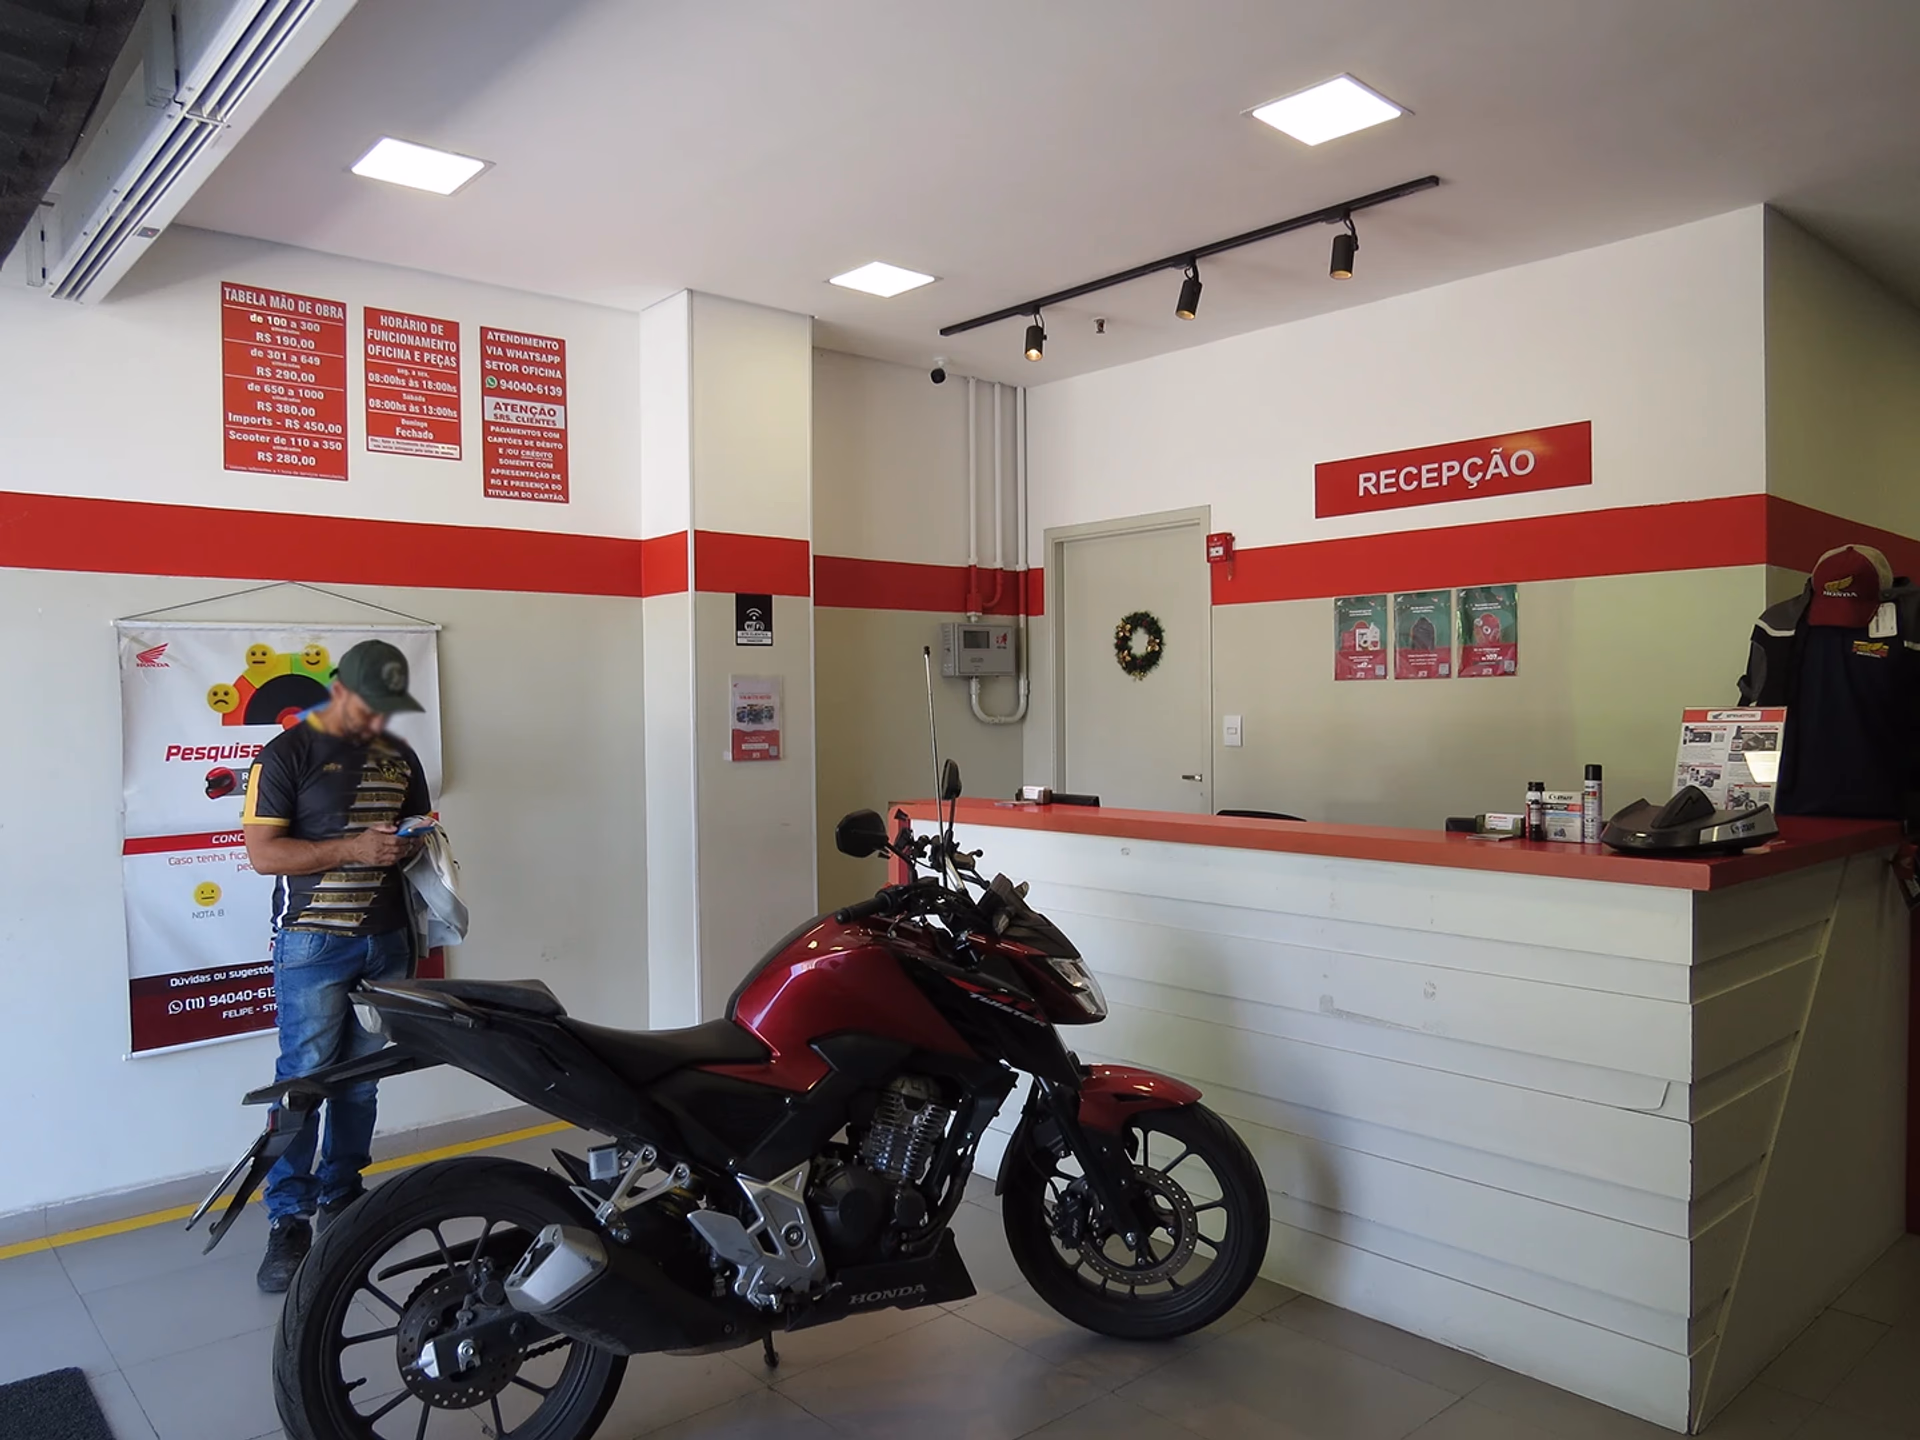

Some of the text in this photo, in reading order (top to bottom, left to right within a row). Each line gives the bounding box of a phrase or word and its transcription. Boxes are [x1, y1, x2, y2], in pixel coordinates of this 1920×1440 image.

[224, 287, 344, 319] TABELA MÃO DE OBRA
[250, 314, 263, 323] de
[267, 315, 287, 326] 100
[291, 320, 296, 328] a
[301, 321, 319, 332] 300
[380, 315, 444, 335] HORÁRIO DE
[256, 332, 314, 349] R$ 190,00
[367, 328, 456, 352] FUNCIONAMENTO
[487, 331, 559, 350] ATENDIMENTO
[251, 348, 263, 357] de
[267, 350, 286, 361] 301
[301, 355, 320, 365] 649
[368, 344, 457, 368] OFICINA E PEÇAS
[486, 346, 560, 364] VIA WHATSAPP
[256, 366, 315, 382] R$ 290,00
[485, 360, 562, 379] SETOR OFICINA
[368, 373, 406, 385] 08:00hs
[500, 379, 562, 396] 94040-6139
[247, 383, 260, 392] de
[264, 384, 284, 395] 650
[288, 388, 294, 396] a
[299, 389, 323, 400] 1000
[257, 401, 315, 417] R$ 380,00
[369, 399, 406, 412] 08:00hs
[494, 402, 556, 417] ATENÇÃO
[228, 412, 272, 426] Imports
[285, 419, 299, 430] R$
[304, 421, 342, 434] 450,00
[516, 416, 556, 426] CLIENTES
[396, 427, 433, 440] Fechado
[490, 426, 541, 436] PAGAMENTOS
[229, 430, 270, 442] Scooter
[274, 436, 286, 445] de
[290, 438, 309, 447] 110
[323, 441, 342, 451] 350
[257, 451, 315, 466] R$ 280,00
[499, 459, 534, 467] SOMENTE
[1358, 448, 1535, 496] RECEPÇÃO
[488, 489, 519, 497] TITULAR
[165, 742, 264, 762] Pesquisa
[168, 857, 193, 865] Caso
[197, 853, 225, 863] tenha
[192, 911, 215, 919] NOTA
[170, 975, 210, 987] Dúvidas
[214, 972, 226, 980] ou
[223, 1007, 253, 1018] FELIPE
[849, 1284, 926, 1304] HONDA
